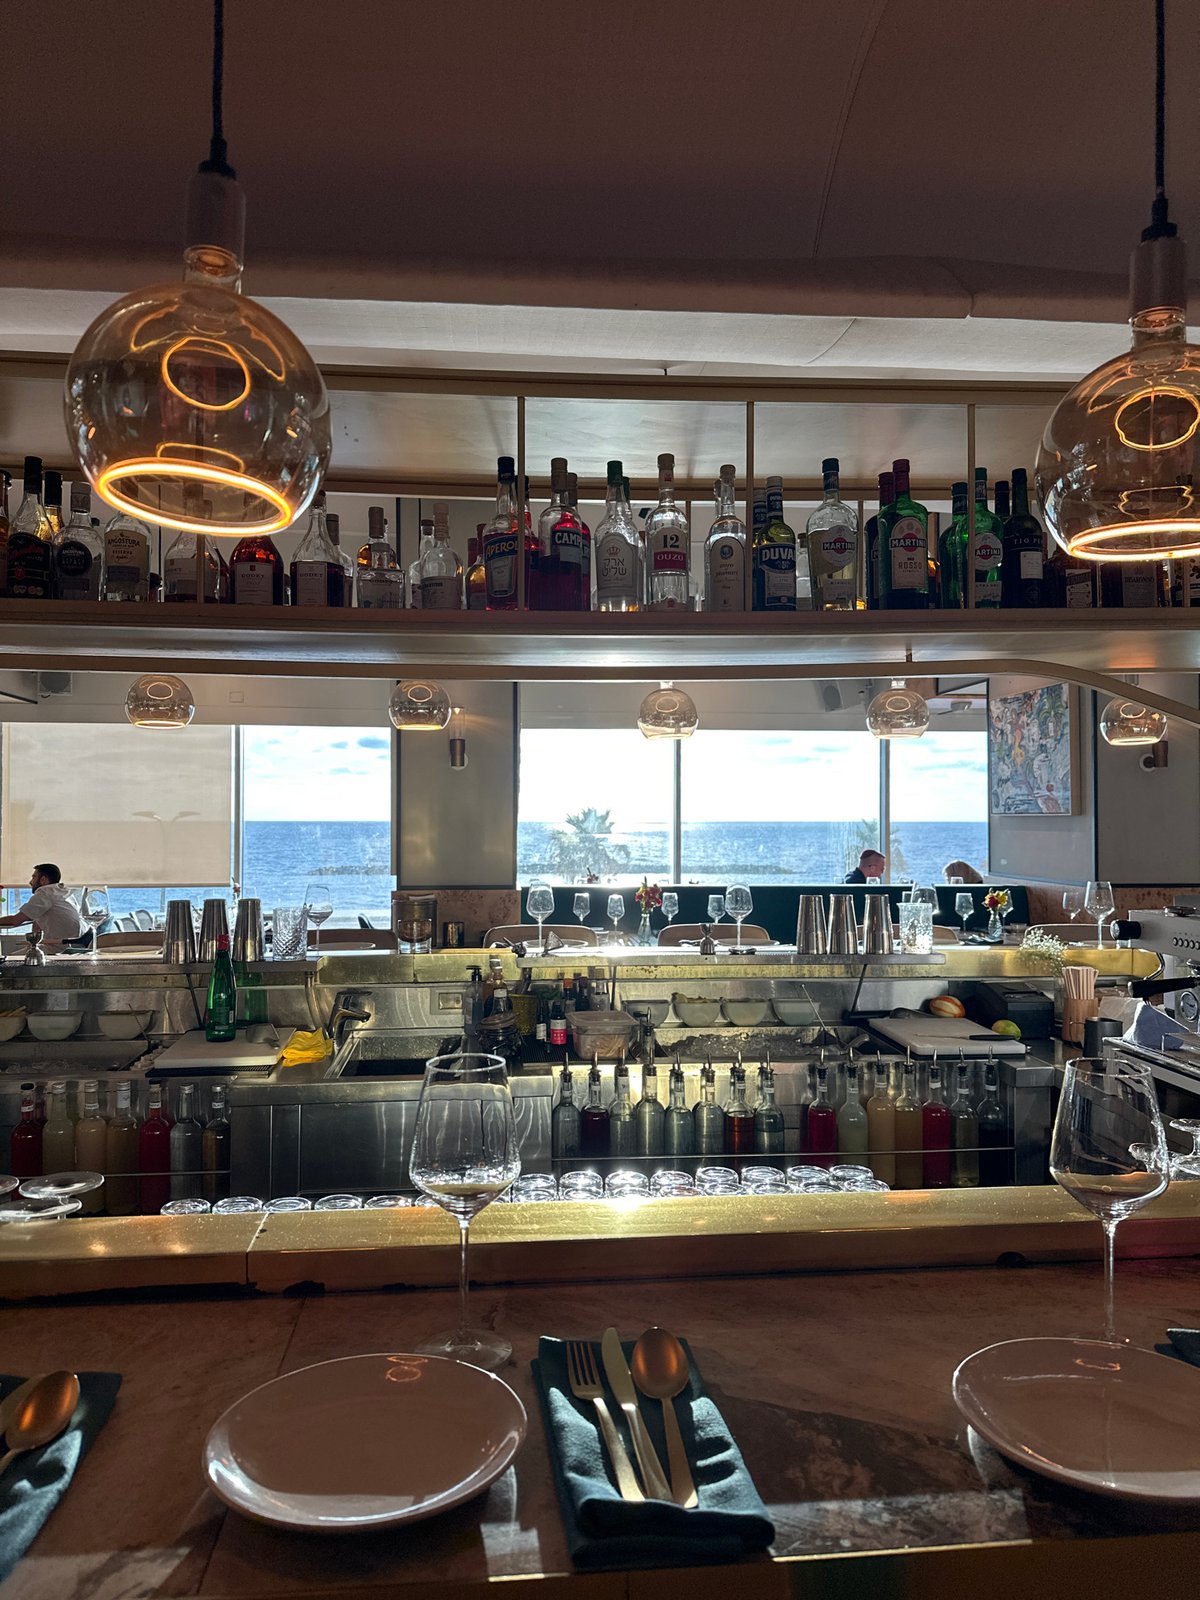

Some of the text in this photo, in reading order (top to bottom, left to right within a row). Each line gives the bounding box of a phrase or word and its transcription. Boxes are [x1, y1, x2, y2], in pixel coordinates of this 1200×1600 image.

[107, 537, 141, 547] ANGOSTURA
[662, 534, 680, 549] 12
[891, 538, 926, 548] MARTINI
[1014, 537, 1029, 545] TIO
[486, 540, 518, 558] APEROL
[823, 541, 855, 551] MARTINI
[975, 548, 1001, 557] ARTINI
[656, 553, 684, 562] OUZO
[603, 558, 625, 567] ארק
[898, 561, 923, 570] ROSSO
